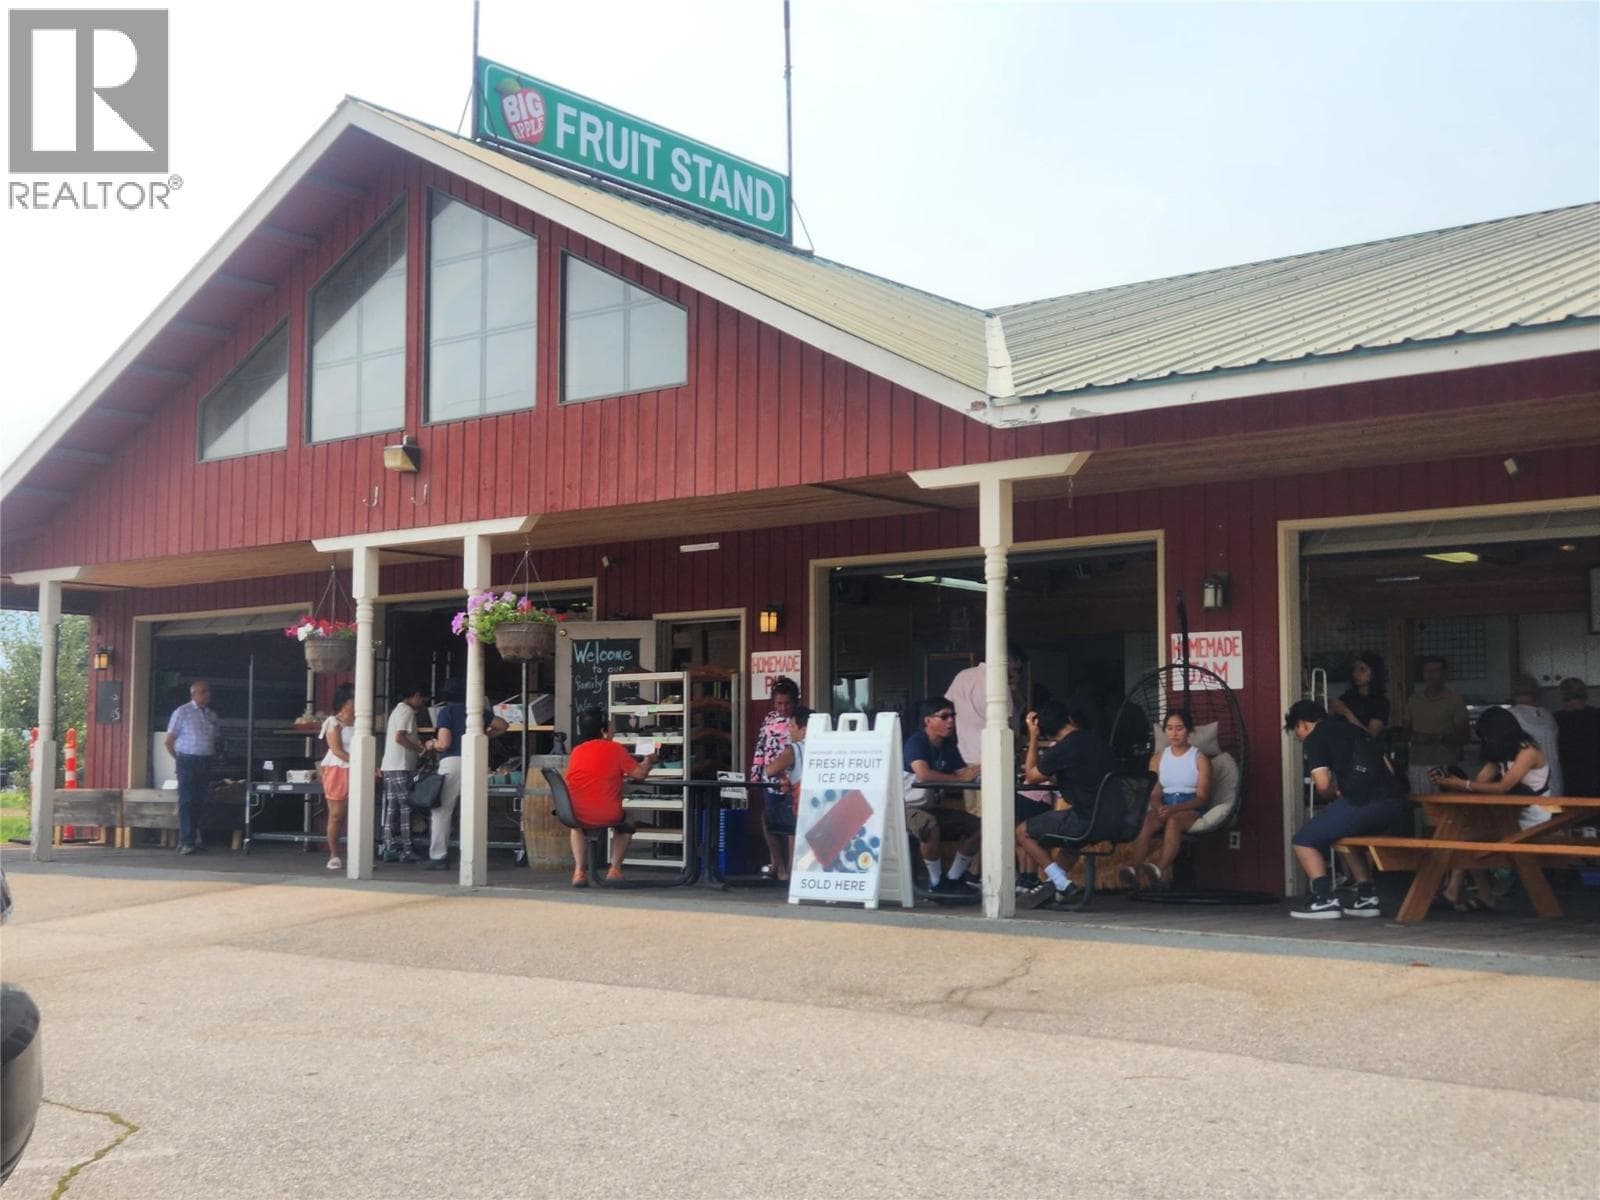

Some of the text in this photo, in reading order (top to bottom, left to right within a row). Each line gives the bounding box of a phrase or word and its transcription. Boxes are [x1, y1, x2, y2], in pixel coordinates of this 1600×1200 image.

[502, 91, 545, 124] BIG
[511, 116, 544, 139] APPLE
[556, 102, 776, 222] FRUIT STAND
[573, 641, 633, 664] Welcome
[1171, 636, 1241, 659] HMEMADE
[752, 655, 800, 673] HOMEMADE
[808, 758, 883, 769] FRESH FRUIT
[818, 773, 871, 783] ICE POPS
[800, 878, 867, 891] SOLD HERE
